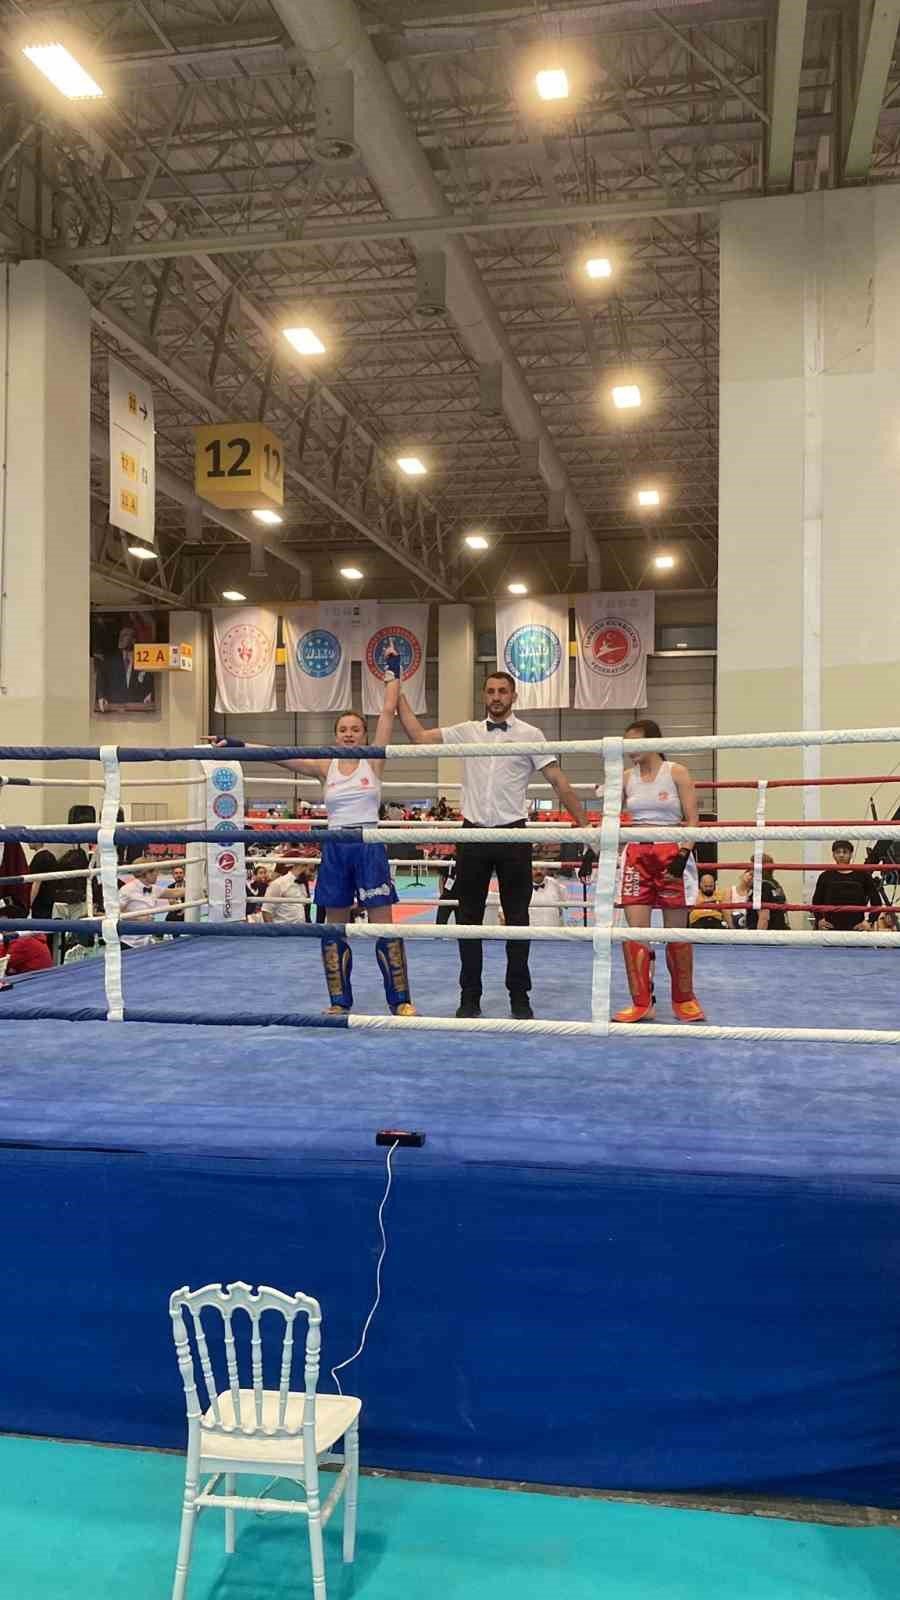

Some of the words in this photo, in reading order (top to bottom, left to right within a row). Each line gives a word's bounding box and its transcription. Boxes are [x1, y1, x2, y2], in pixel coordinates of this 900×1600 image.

[205, 438, 251, 477] 12
[263, 443, 281, 487] 12
[136, 650, 149, 663] 12
[156, 649, 165, 662] A
[623, 864, 635, 896] KICK
